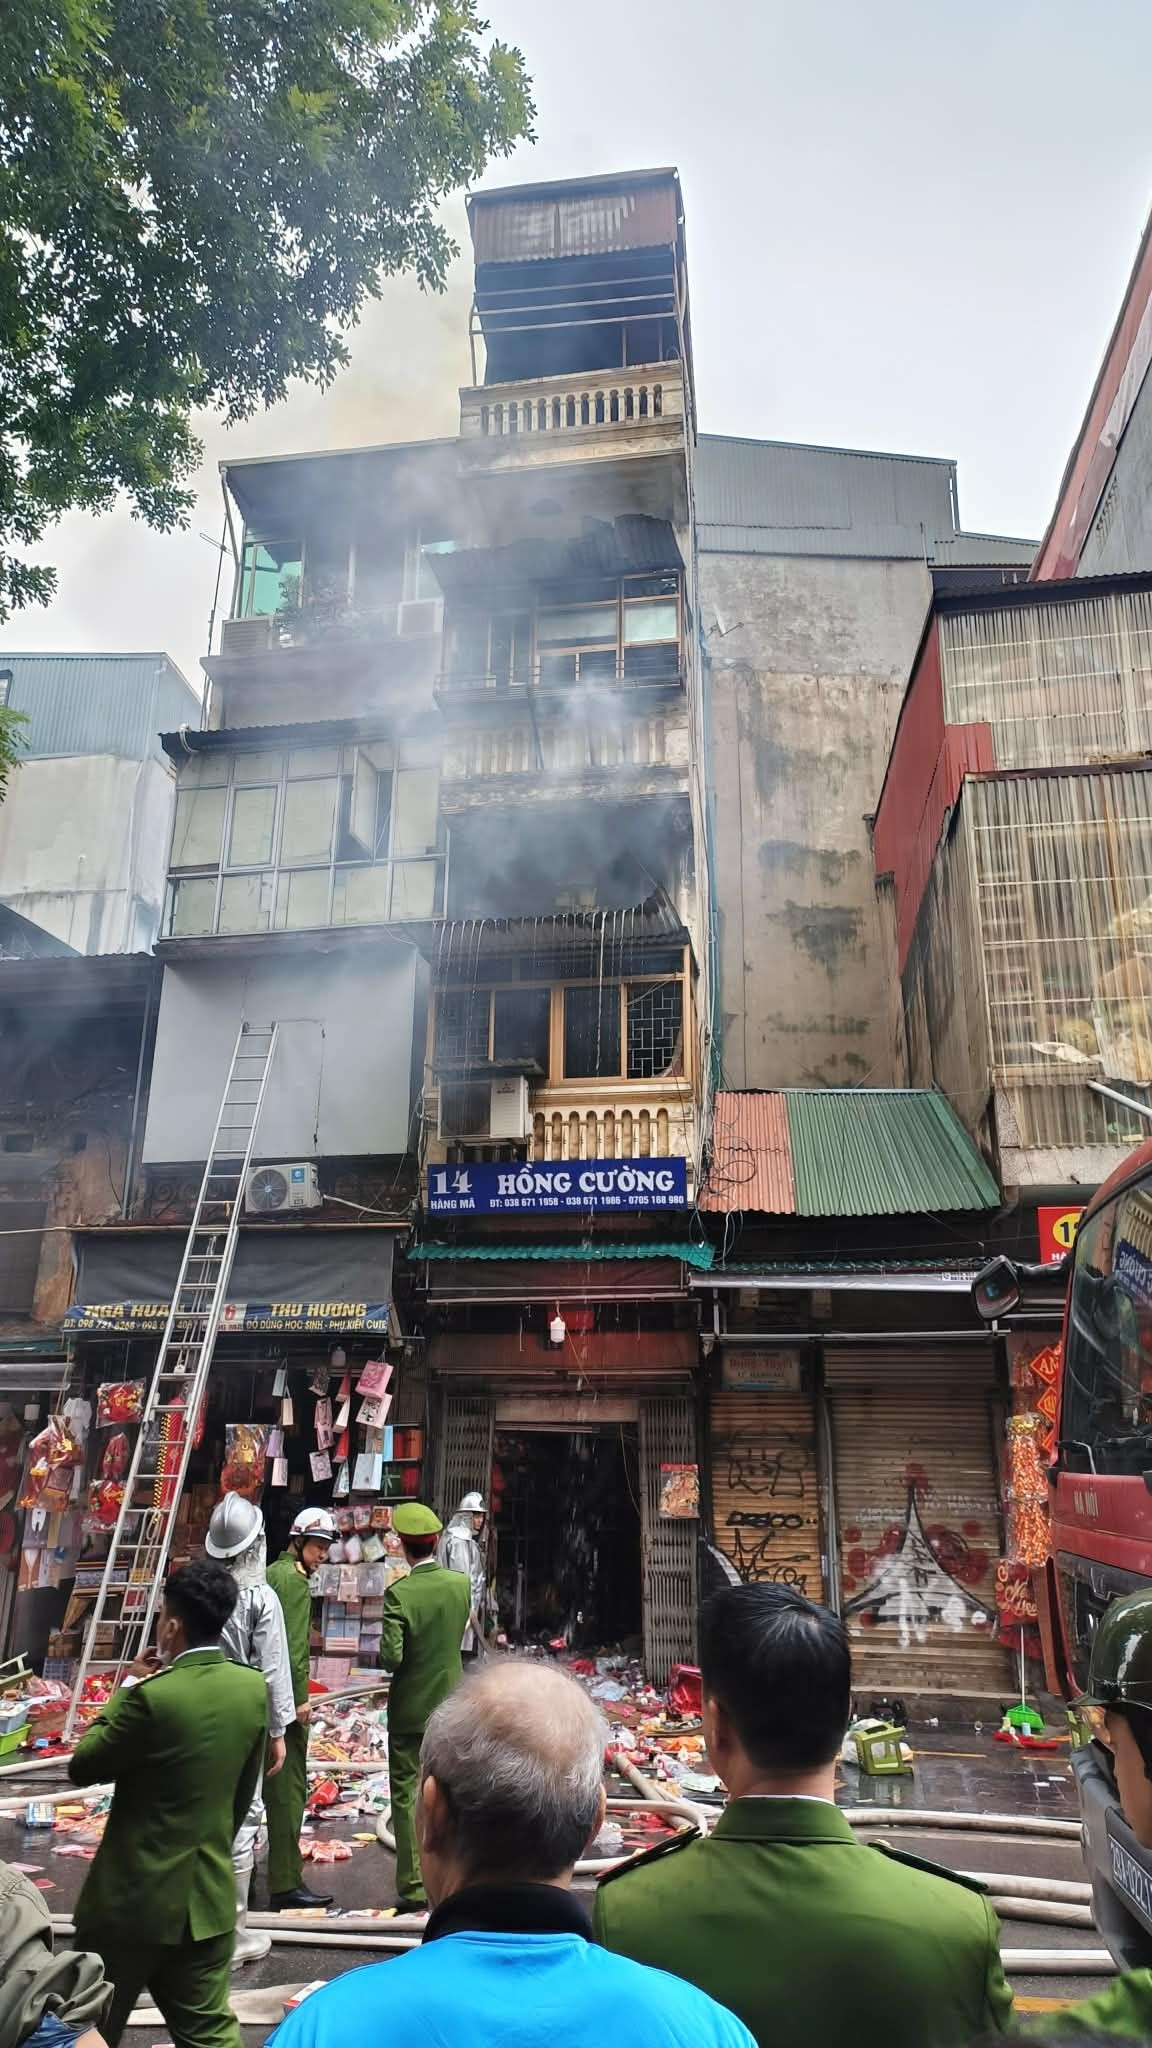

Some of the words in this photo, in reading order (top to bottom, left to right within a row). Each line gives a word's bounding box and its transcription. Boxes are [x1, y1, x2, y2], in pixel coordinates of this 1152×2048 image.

[432, 1170, 473, 1195] 14
[497, 1163, 572, 1194] HỒNG
[579, 1165, 675, 1193] CƯỜNG
[430, 1198, 457, 1209] HÀNG
[504, 1198, 520, 1207] 038
[521, 1198, 536, 1207] 671
[566, 1197, 581, 1206] 038
[583, 1197, 598, 1205] 671
[224, 1304, 237, 1321] 6
[271, 1303, 303, 1317] THU
[366, 1319, 387, 1329] CUTE
